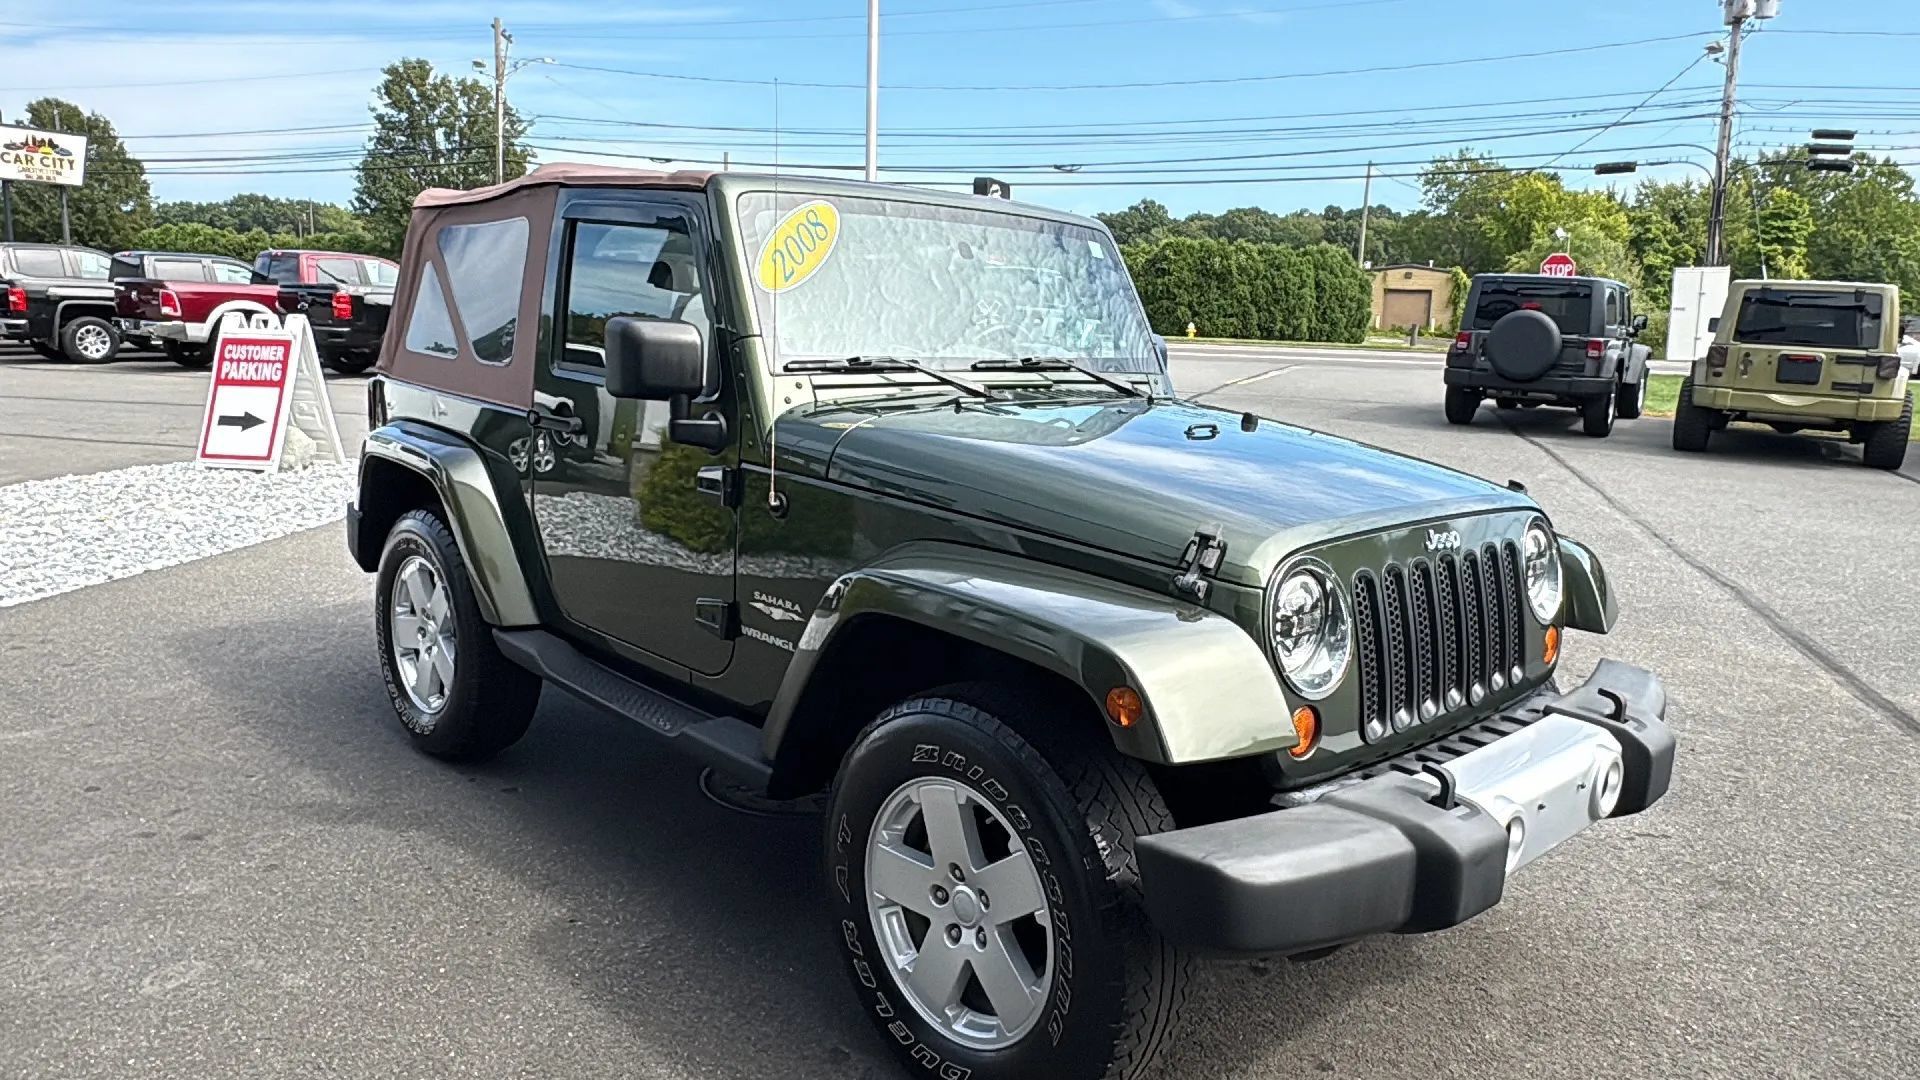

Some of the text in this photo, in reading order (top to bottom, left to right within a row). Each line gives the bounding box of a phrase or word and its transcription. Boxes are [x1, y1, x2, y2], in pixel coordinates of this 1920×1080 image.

[0, 151, 75, 170] CAR CITY
[771, 209, 829, 282] 2008
[1543, 263, 1573, 276] STOP
[223, 344, 285, 361] CUSTOMER
[220, 361, 283, 381] PARKING
[1425, 529, 1461, 551] Jeep
[753, 591, 802, 613] SAHARA
[741, 624, 796, 652] WRANGL
[911, 744, 1073, 1047] BRIDGESTONE
